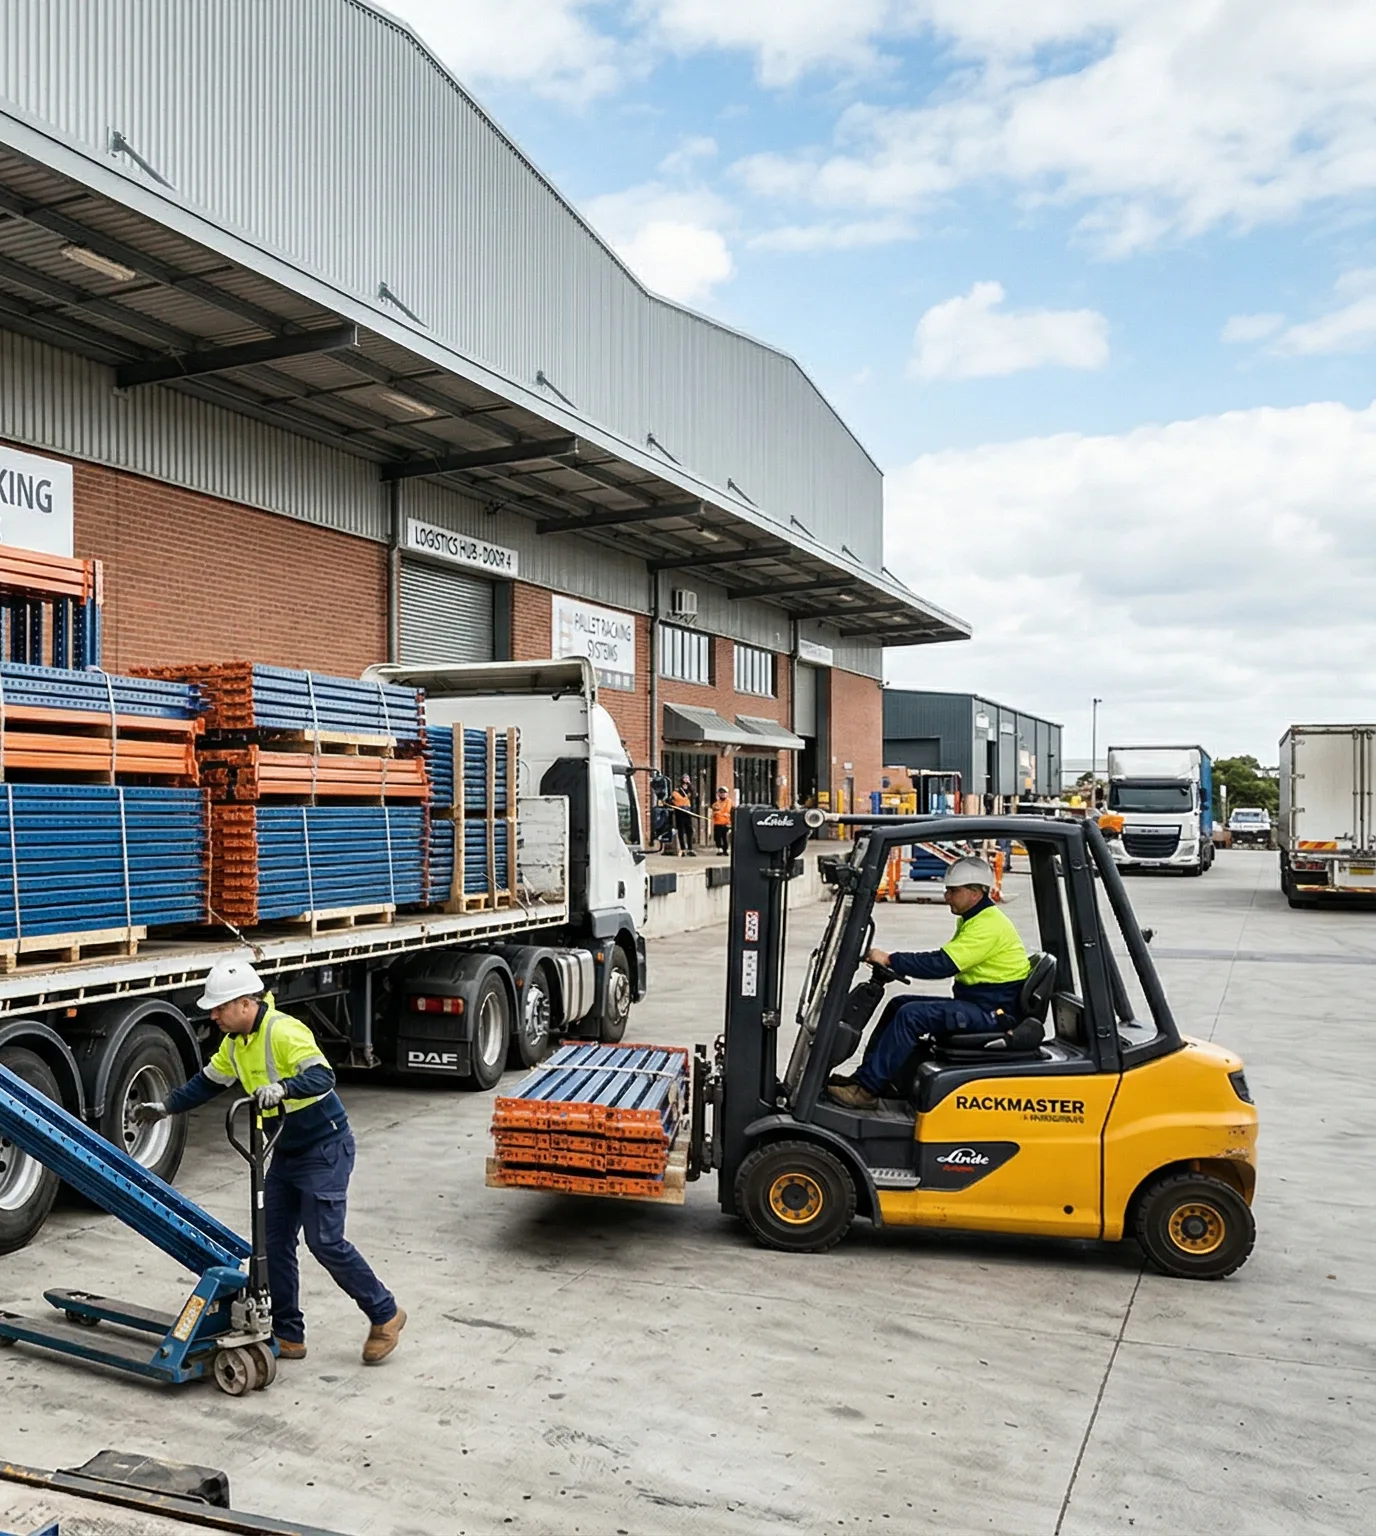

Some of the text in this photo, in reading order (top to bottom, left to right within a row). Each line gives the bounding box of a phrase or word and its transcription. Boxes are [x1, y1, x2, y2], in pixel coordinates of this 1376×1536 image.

[415, 525, 459, 556] LOGISTICS
[407, 1050, 458, 1064] DAF
[956, 1095, 1085, 1115] RACKMASTER
[936, 1147, 990, 1165] Linde
